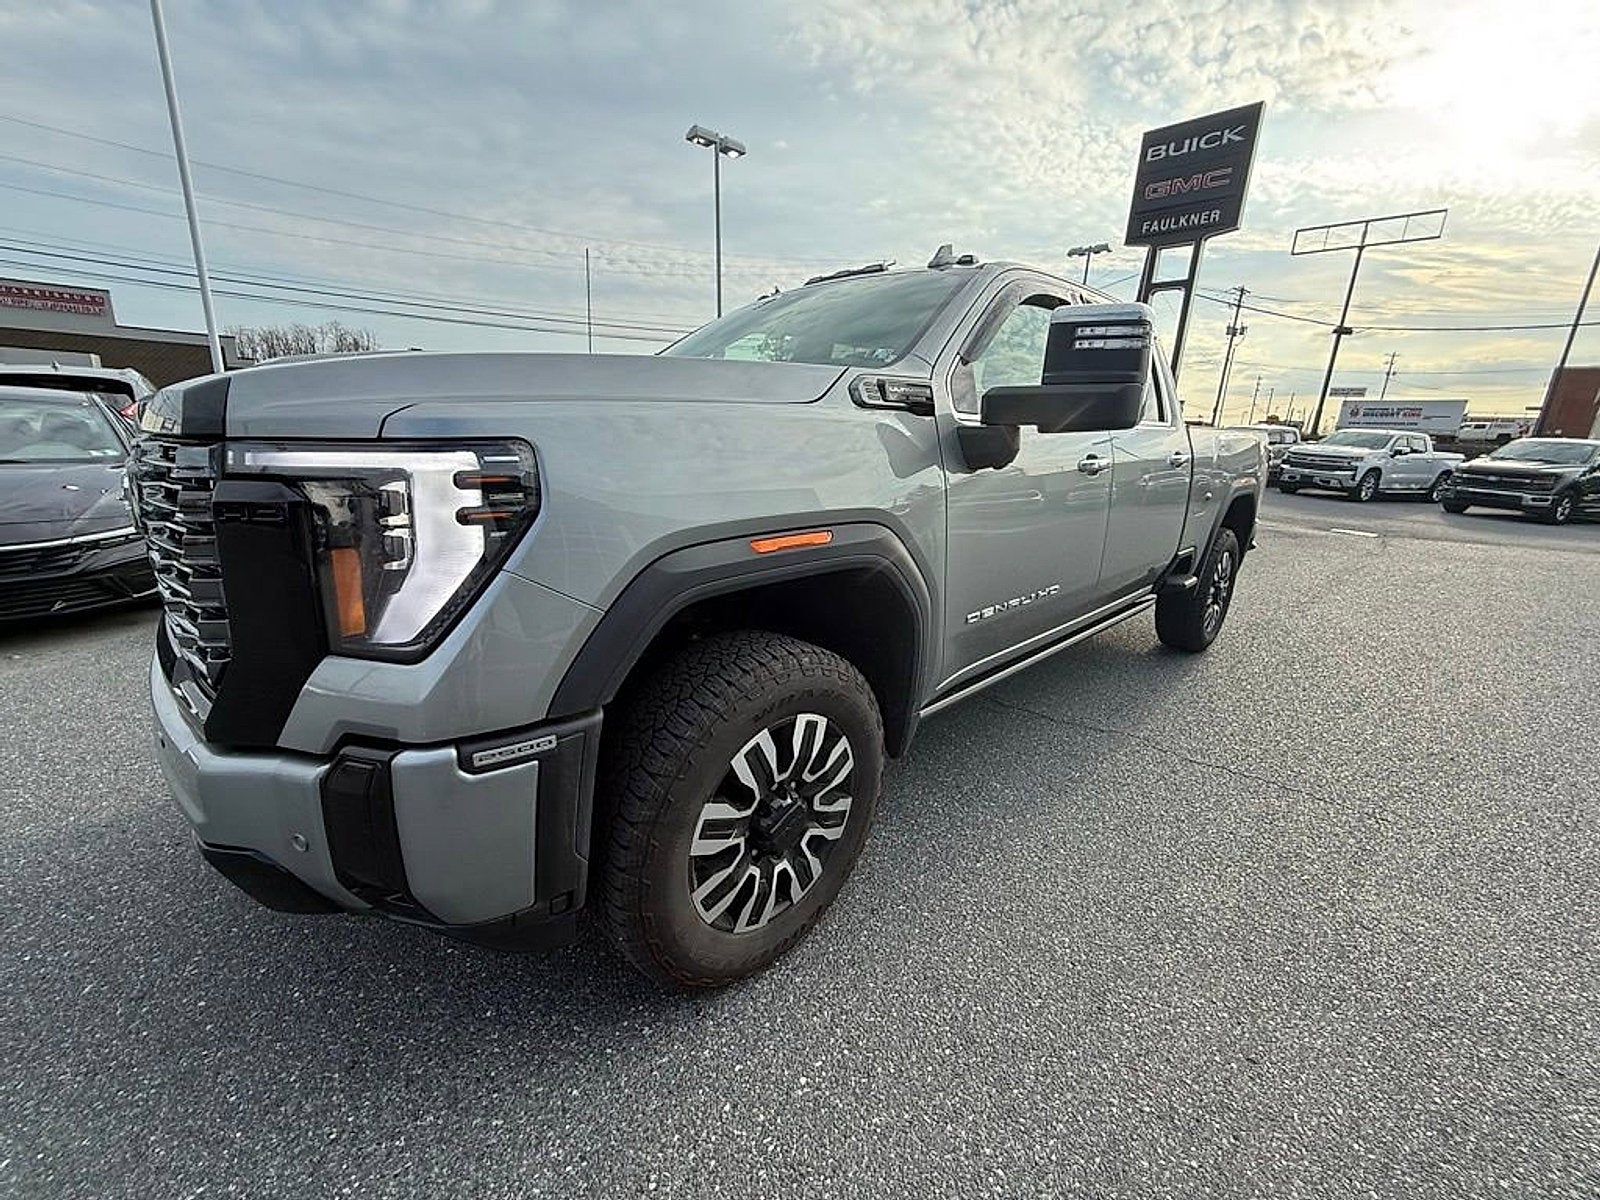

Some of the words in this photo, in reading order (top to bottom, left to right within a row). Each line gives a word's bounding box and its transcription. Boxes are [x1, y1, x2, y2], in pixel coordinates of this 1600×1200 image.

[1146, 125, 1247, 162] BUICK
[1145, 167, 1233, 200] GMC
[1142, 209, 1221, 234] FAULKNER
